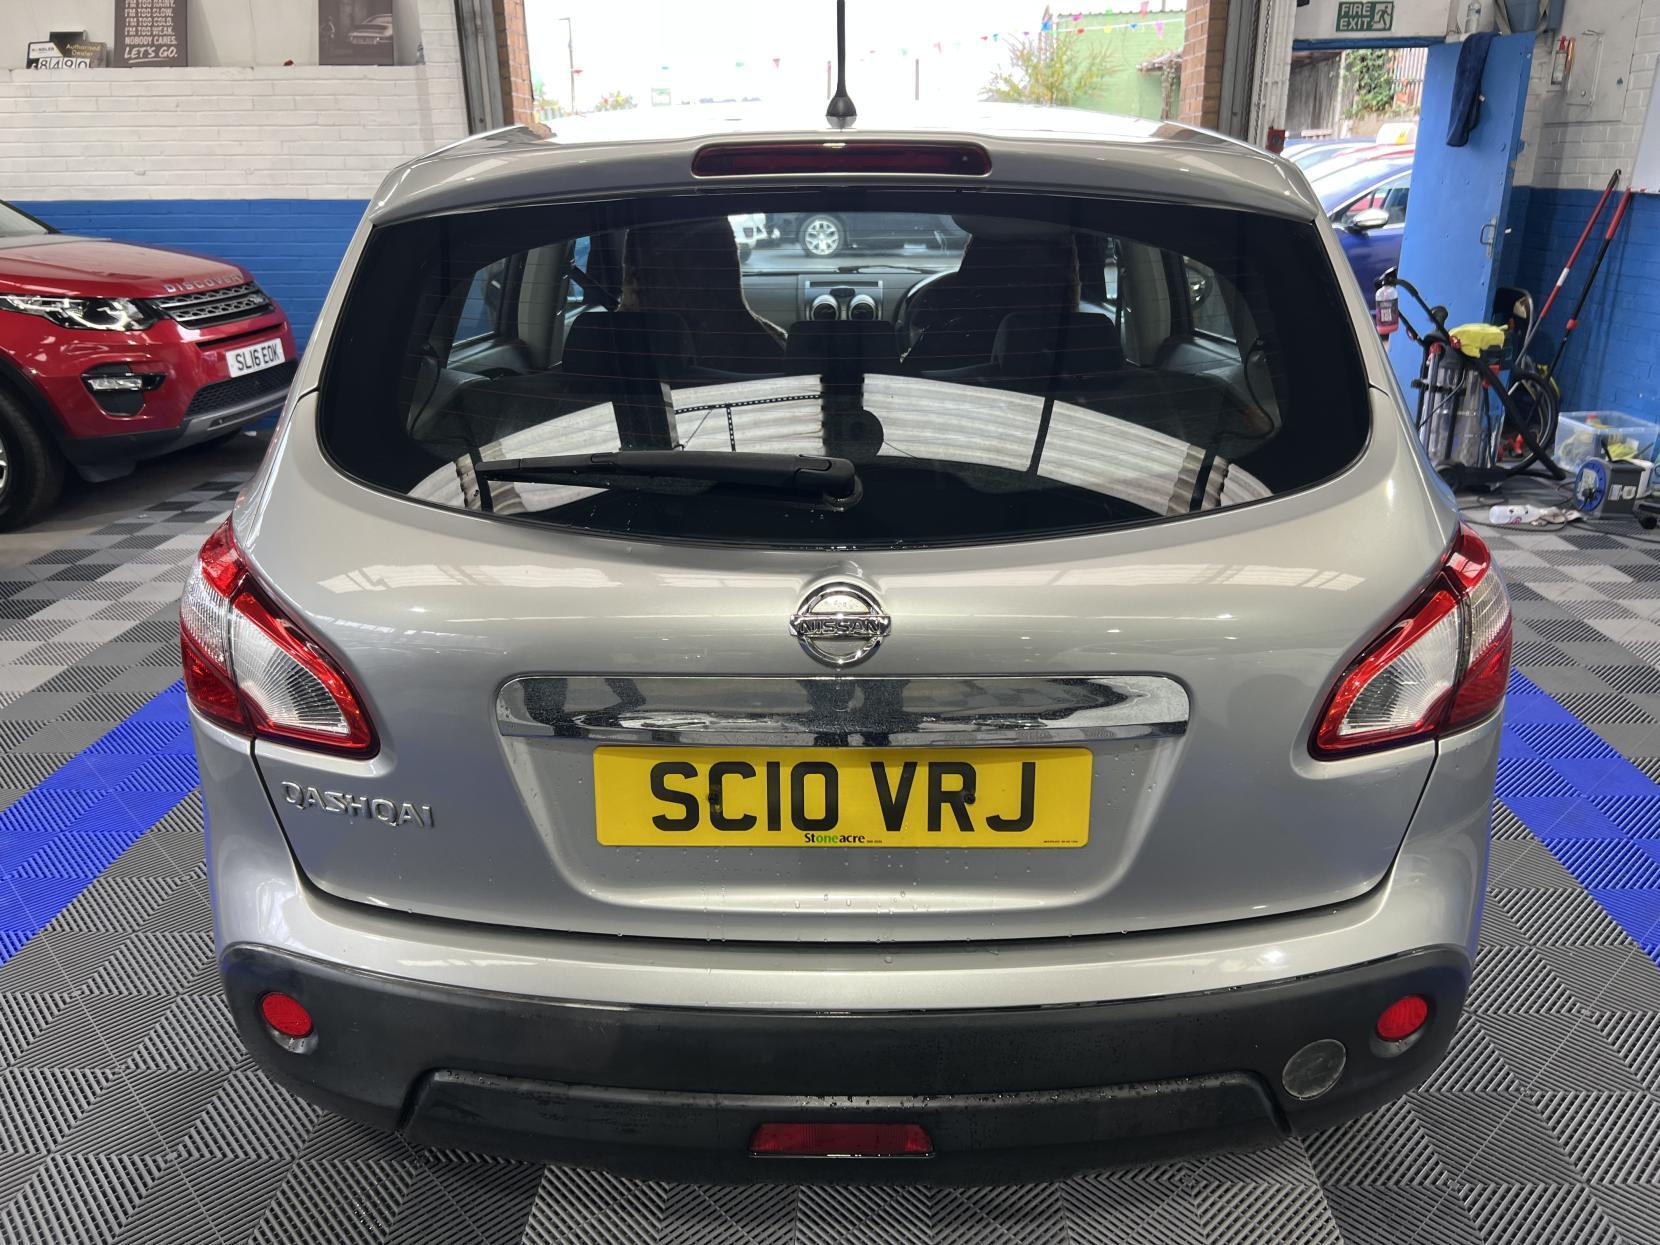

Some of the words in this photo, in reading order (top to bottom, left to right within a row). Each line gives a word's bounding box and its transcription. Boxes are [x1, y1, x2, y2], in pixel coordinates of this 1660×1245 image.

[125, 8, 136, 17] I'M
[137, 8, 151, 17] TOO
[152, 8, 174, 17] SLOW.
[1341, 3, 1371, 16] FIRE
[126, 17, 137, 26] I'M
[138, 17, 152, 26] TOO
[153, 17, 174, 26] COLD.
[1340, 17, 1371, 30] EXIT
[125, 26, 136, 35] I'M
[137, 26, 151, 35] TOO
[152, 26, 175, 35] WEAK.
[125, 36, 152, 45] NOBODY
[153, 36, 178, 45] CARES.
[124, 46, 156, 59] LET'S
[158, 46, 178, 58] GO.
[235, 349, 262, 371] SL16
[261, 343, 280, 364] EOK
[799, 618, 881, 635] NISSAN
[649, 761, 839, 832] SC10
[871, 761, 1037, 832] VRJ
[277, 780, 434, 828] QASHQAI
[804, 832, 866, 844] Stoneacre
